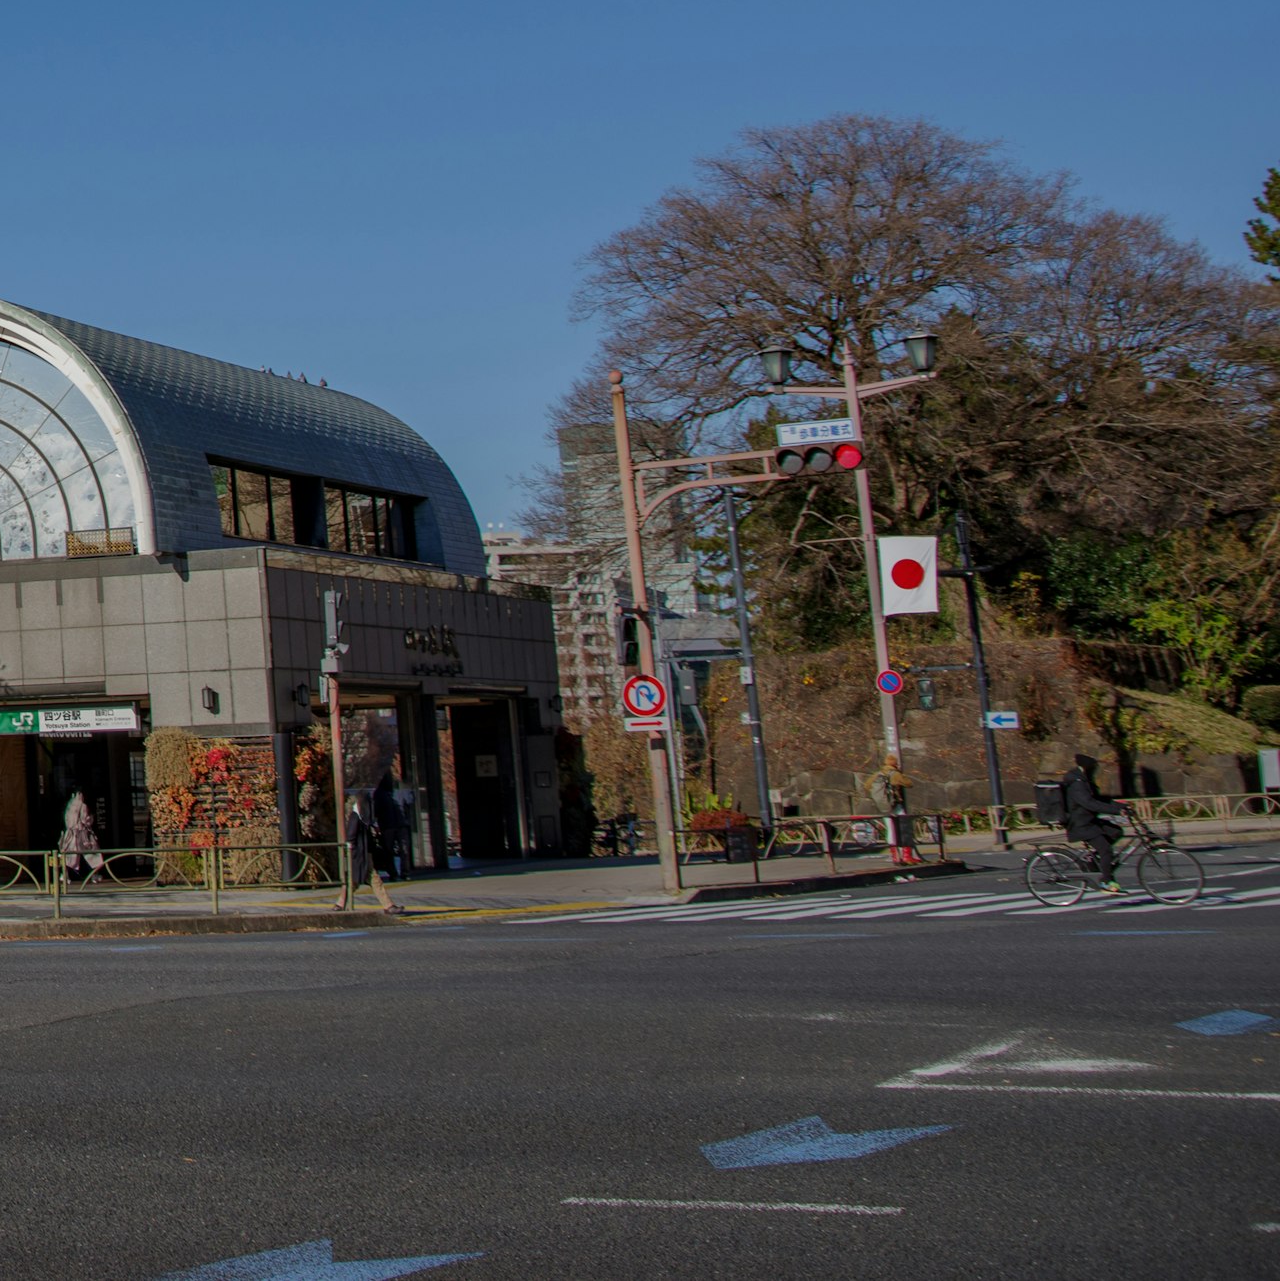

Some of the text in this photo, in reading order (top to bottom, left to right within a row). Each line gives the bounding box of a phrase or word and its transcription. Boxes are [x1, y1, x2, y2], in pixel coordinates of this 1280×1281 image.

[12, 711, 34, 726] JR
[44, 710, 81, 721] 四ツ谷駅
